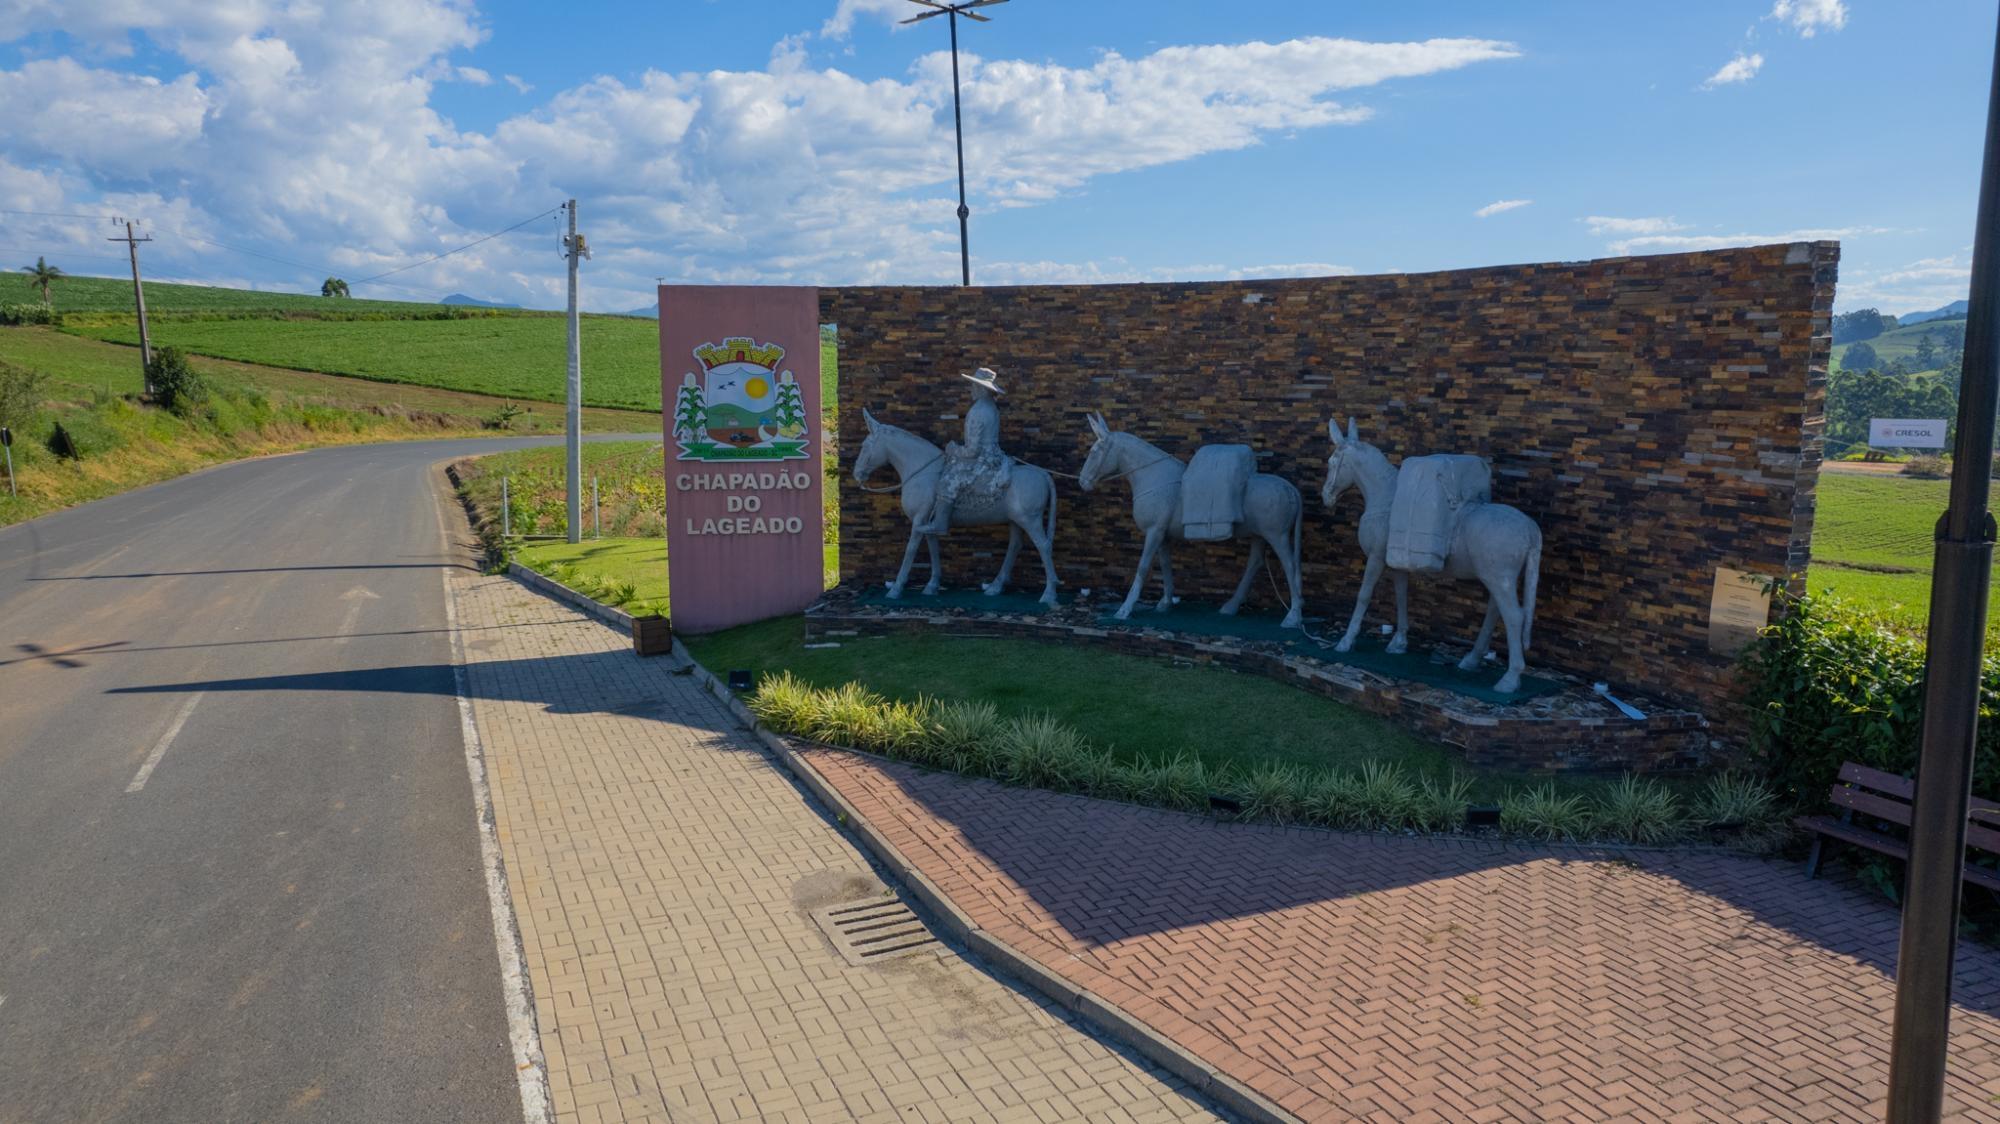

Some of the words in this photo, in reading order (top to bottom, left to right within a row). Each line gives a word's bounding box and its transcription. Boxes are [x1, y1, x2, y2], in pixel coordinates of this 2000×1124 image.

[1895, 429, 1933, 437] CRESOL
[676, 468, 811, 490] CHAPADÃO
[727, 496, 761, 513] DO
[687, 517, 803, 535] LAGEADO
